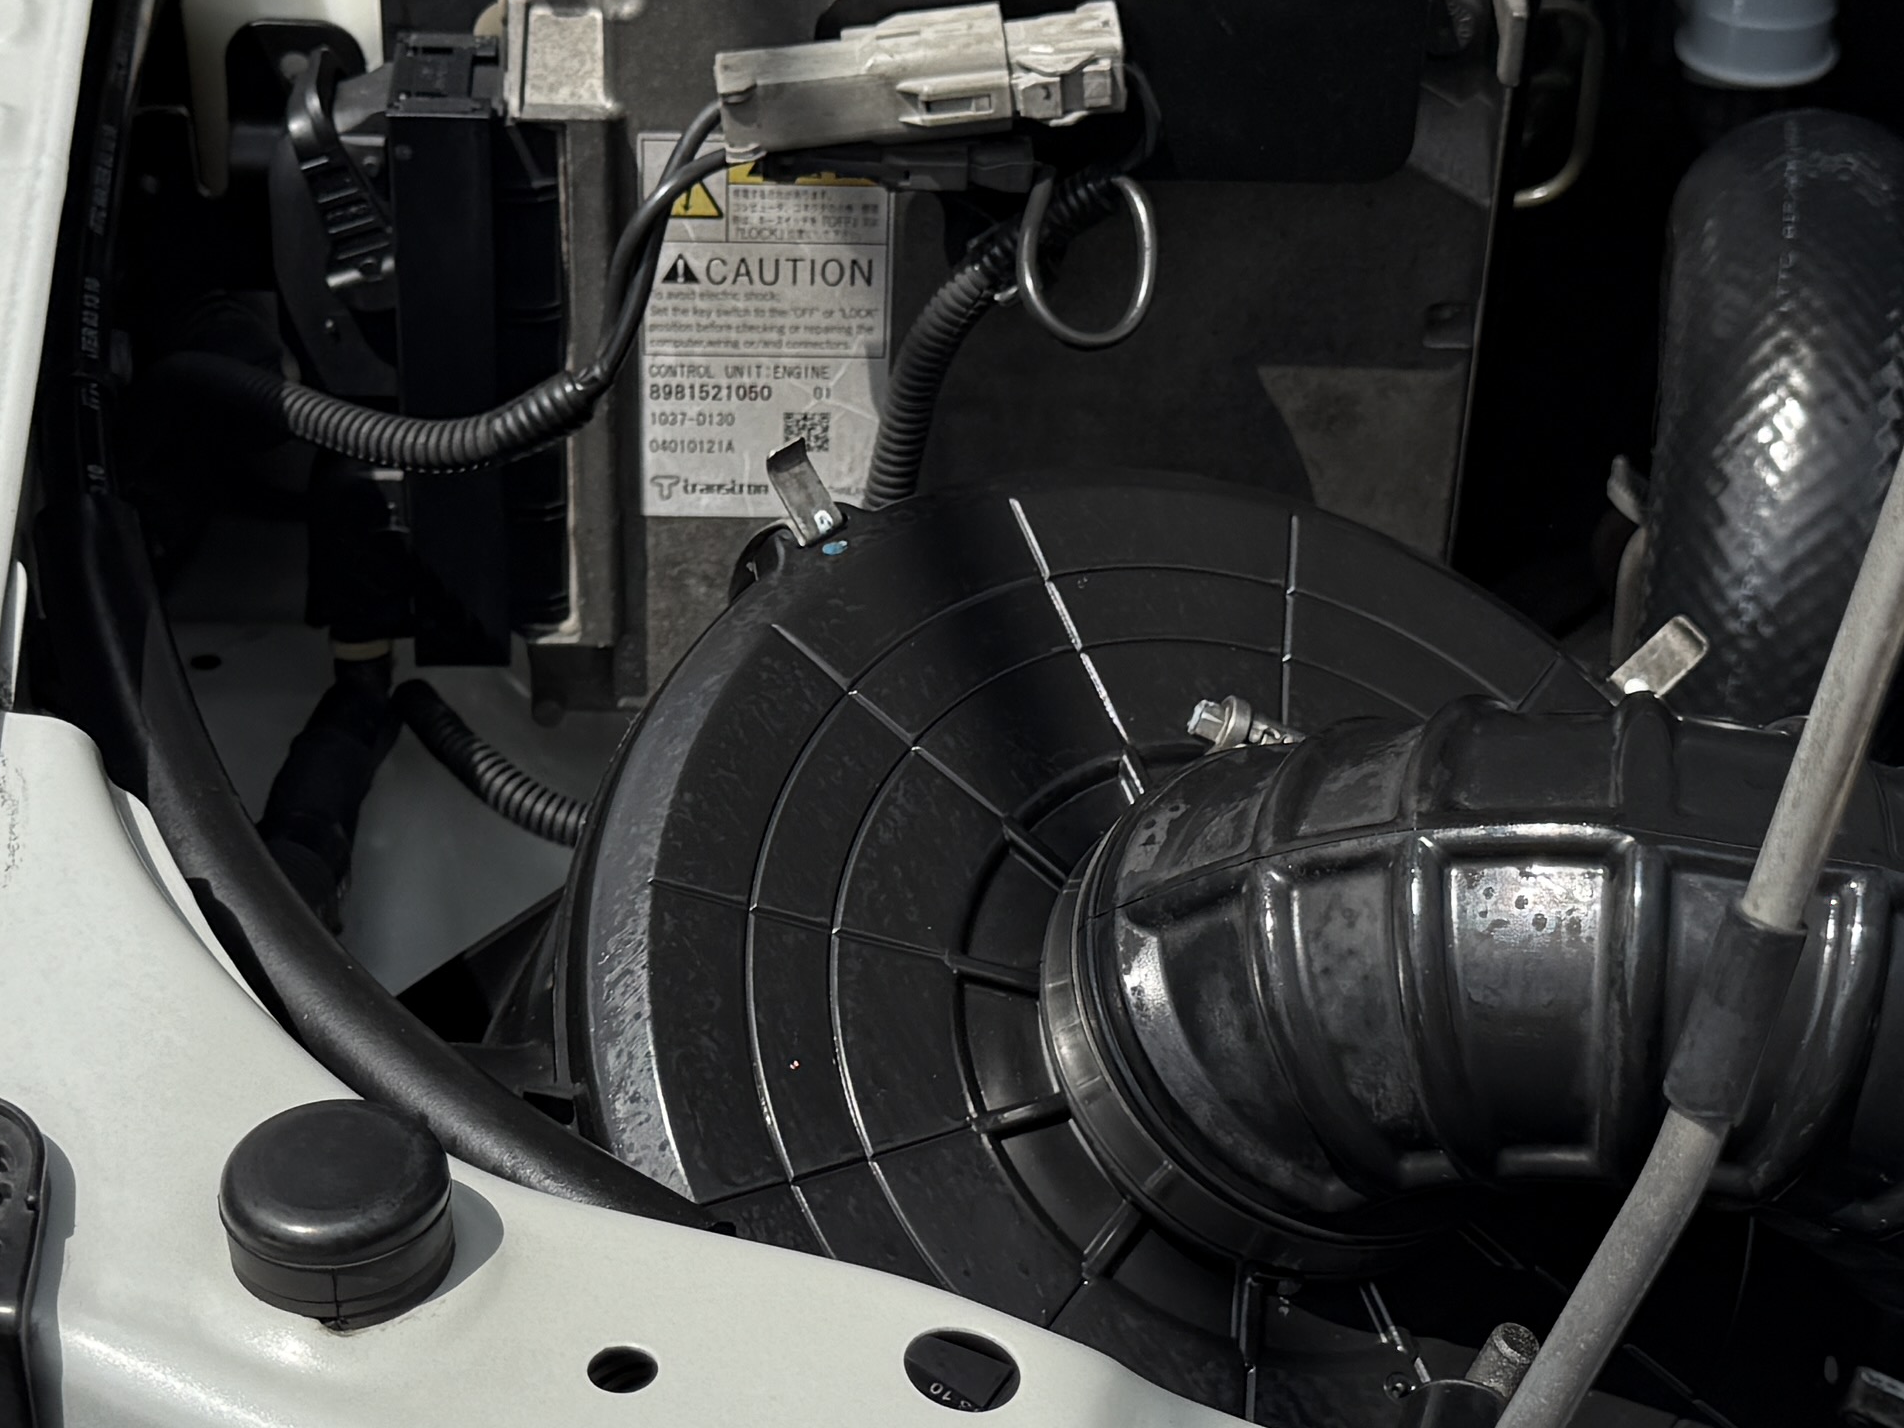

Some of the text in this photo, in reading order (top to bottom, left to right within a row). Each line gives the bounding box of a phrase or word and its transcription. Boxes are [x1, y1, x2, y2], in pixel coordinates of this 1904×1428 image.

[704, 257, 874, 287] CAUTION
[698, 289, 741, 301] electric
[649, 306, 669, 318] Set
[671, 306, 690, 318] the
[648, 322, 694, 335] position
[696, 322, 733, 334] before
[734, 322, 786, 336] checking
[649, 364, 715, 380] CONTROL
[649, 384, 773, 402] 8981521050
[929, 1382, 953, 1402] 10
